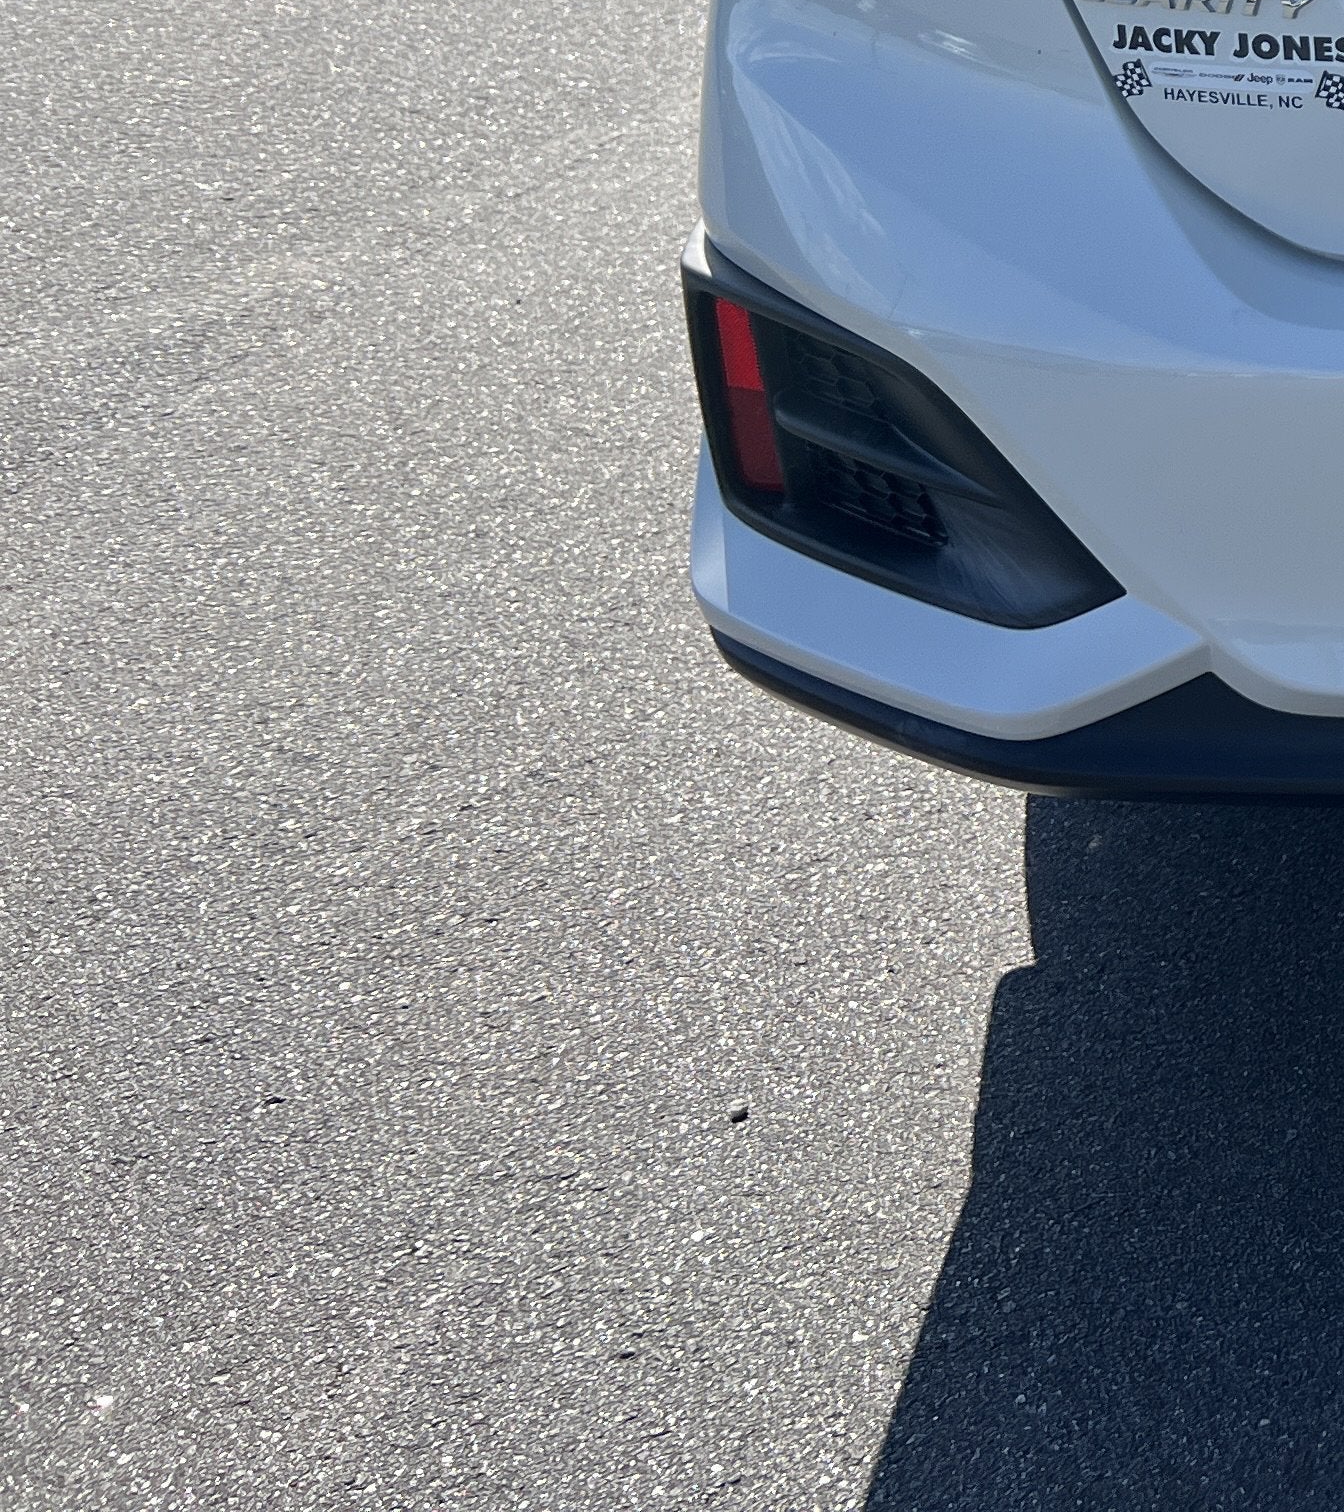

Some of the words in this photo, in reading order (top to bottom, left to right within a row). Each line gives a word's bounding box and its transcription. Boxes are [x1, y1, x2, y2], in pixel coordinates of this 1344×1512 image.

[1112, 23, 1221, 57] JACKY
[1246, 73, 1273, 85] Jeep
[1164, 88, 1273, 110] HAYESVILLE,
[1278, 95, 1304, 109] NC
